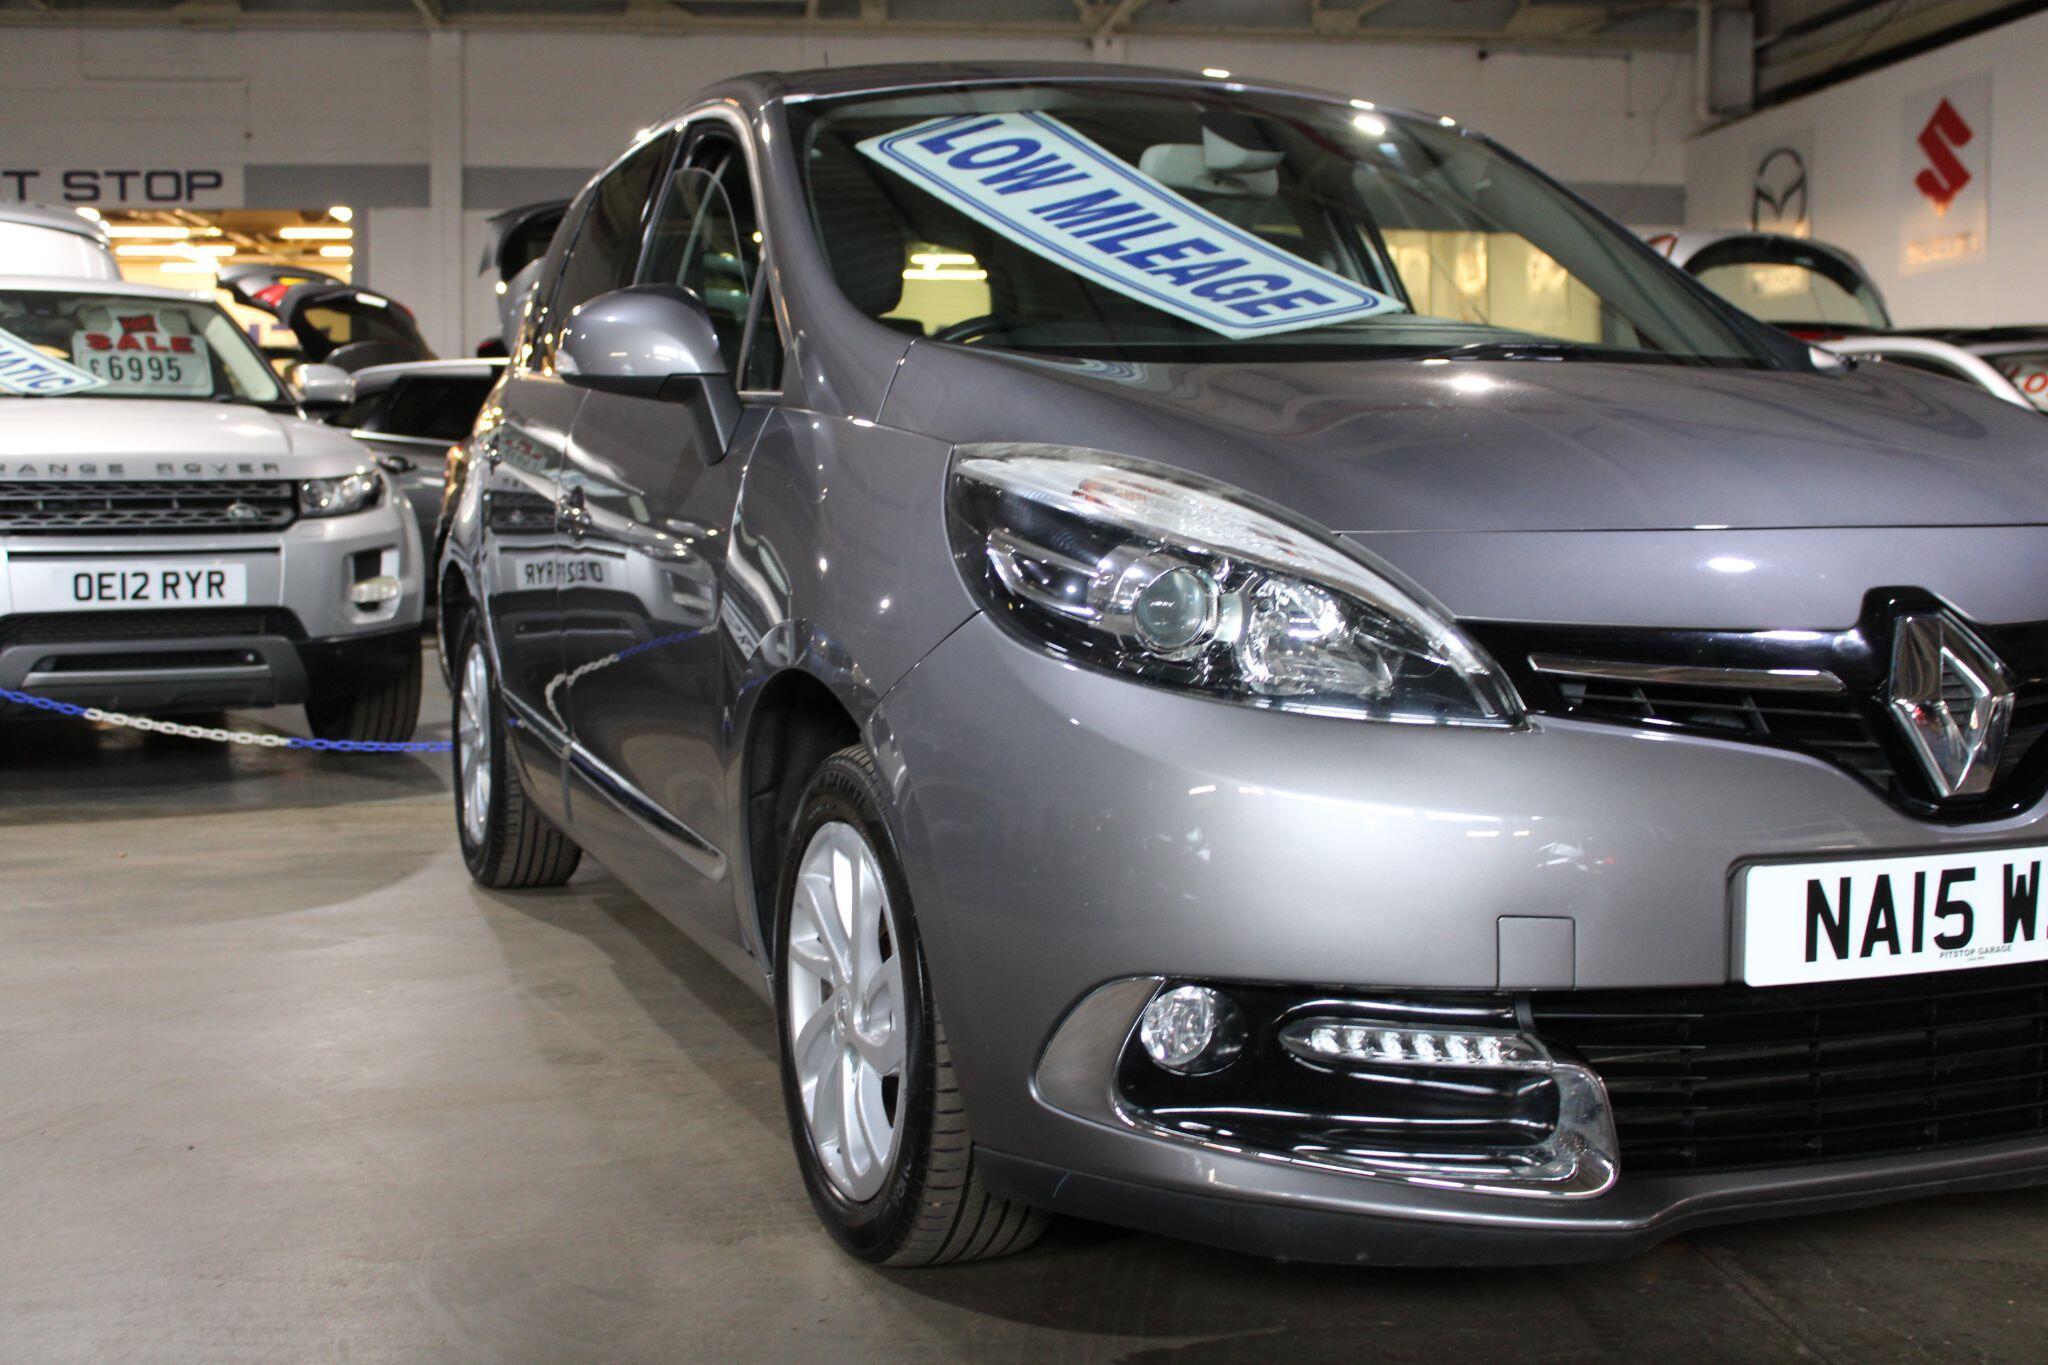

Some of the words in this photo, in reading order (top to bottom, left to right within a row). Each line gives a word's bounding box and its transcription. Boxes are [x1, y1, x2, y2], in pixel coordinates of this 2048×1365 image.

[2, 170, 40, 201] T
[62, 169, 223, 201] STOP
[917, 118, 1093, 196] LOW
[1029, 188, 1342, 318] MILEAGE
[85, 333, 196, 354] SALE
[0, 344, 75, 389] ATIC
[156, 463, 279, 474] ROVER
[73, 572, 149, 601] OE12
[162, 570, 225, 599] RYR
[1805, 867, 1976, 963] NA15
[2003, 860, 2048, 944] W
[1939, 949, 1976, 959] PITSTOP
[1977, 944, 2012, 955] GARAGE
